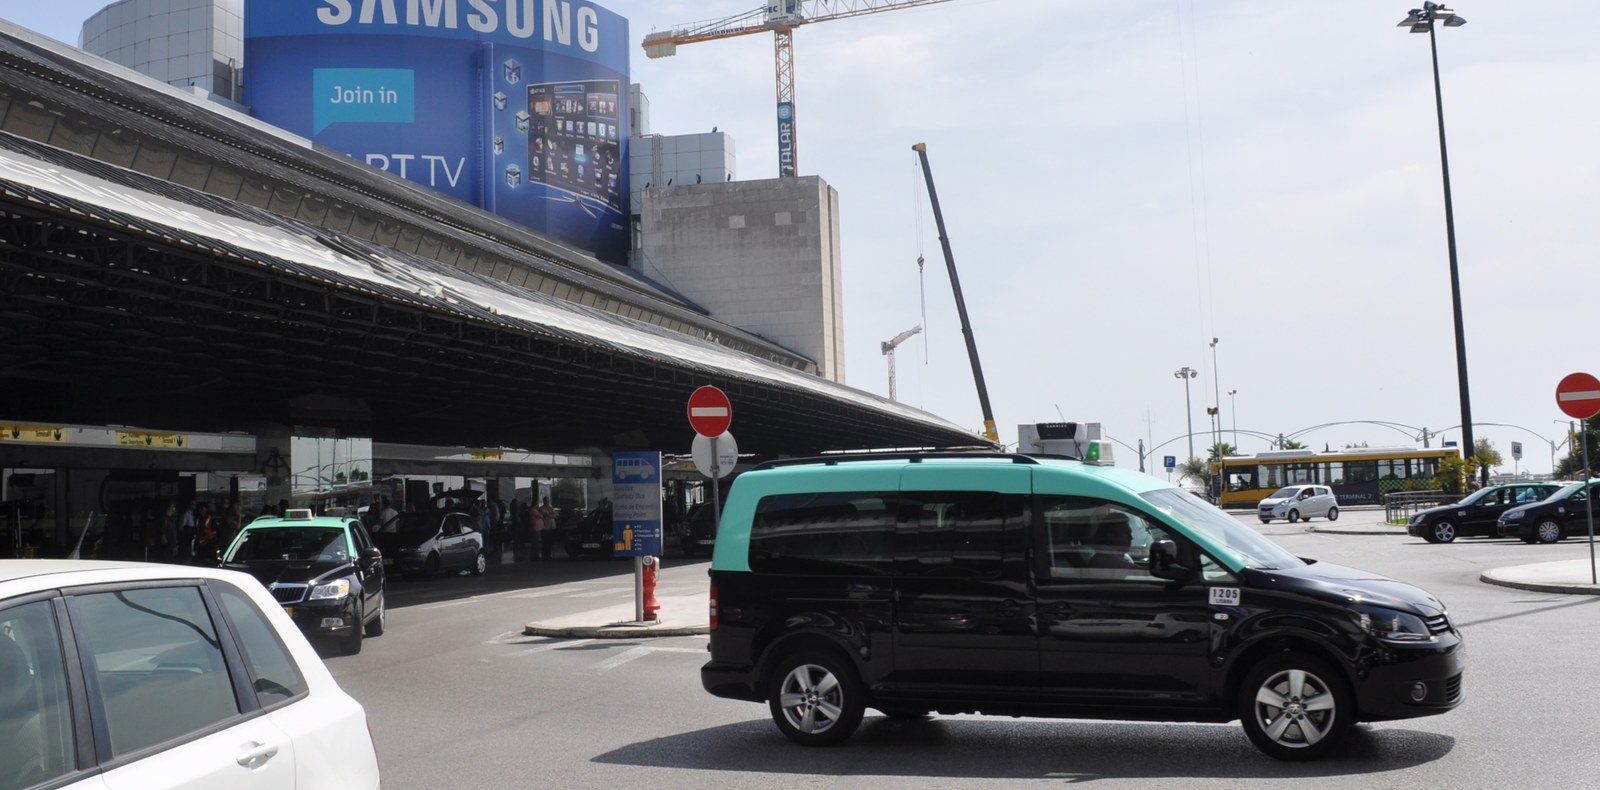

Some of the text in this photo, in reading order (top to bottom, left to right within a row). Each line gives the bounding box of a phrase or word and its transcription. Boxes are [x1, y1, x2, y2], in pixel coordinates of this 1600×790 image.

[316, 0, 599, 53] SAMSUNG
[330, 86, 397, 104] Join in
[421, 154, 466, 188] TV
[1212, 588, 1238, 599] 1205
